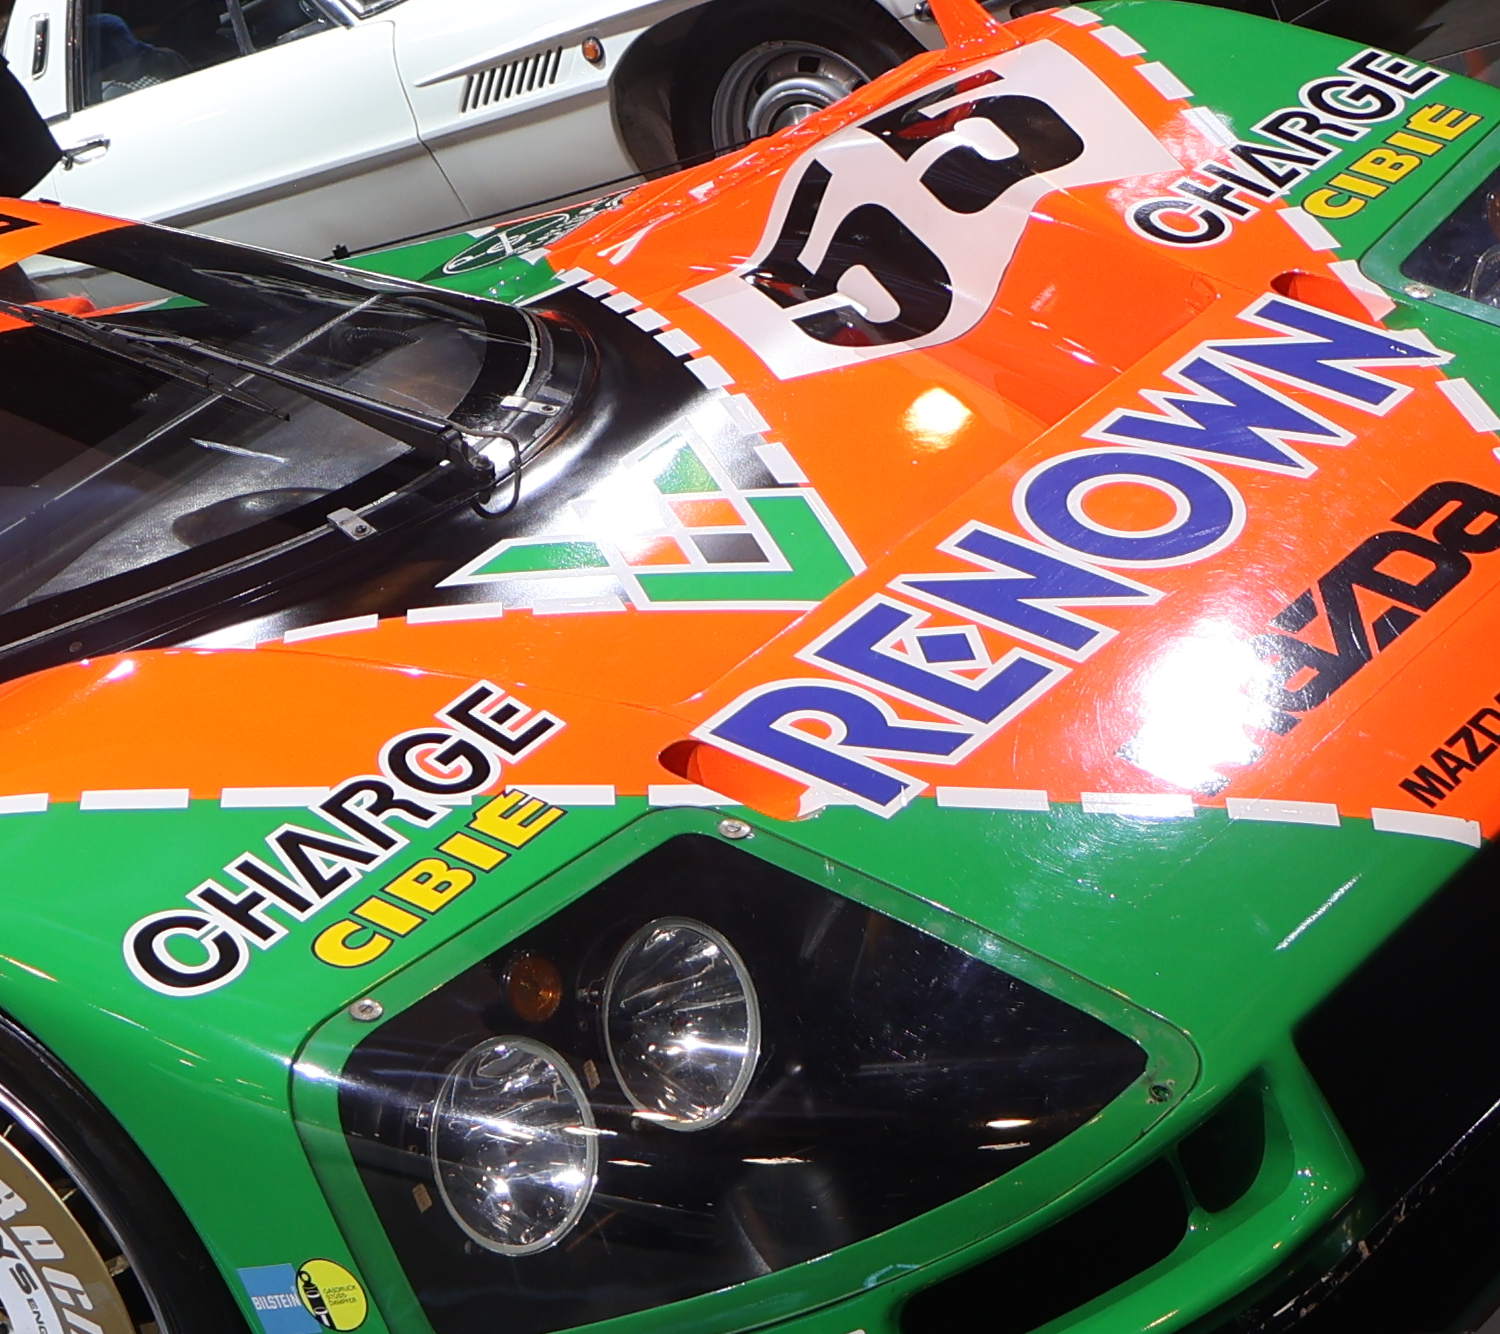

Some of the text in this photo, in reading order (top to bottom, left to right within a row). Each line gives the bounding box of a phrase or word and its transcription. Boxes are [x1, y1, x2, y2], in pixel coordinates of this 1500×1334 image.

[740, 68, 1085, 349] 55
[1124, 47, 1452, 249] CHARGE
[690, 292, 1456, 818] RENOWN
[123, 681, 566, 998] CHARGE
[250, 1292, 302, 1311] BILSTEIN
